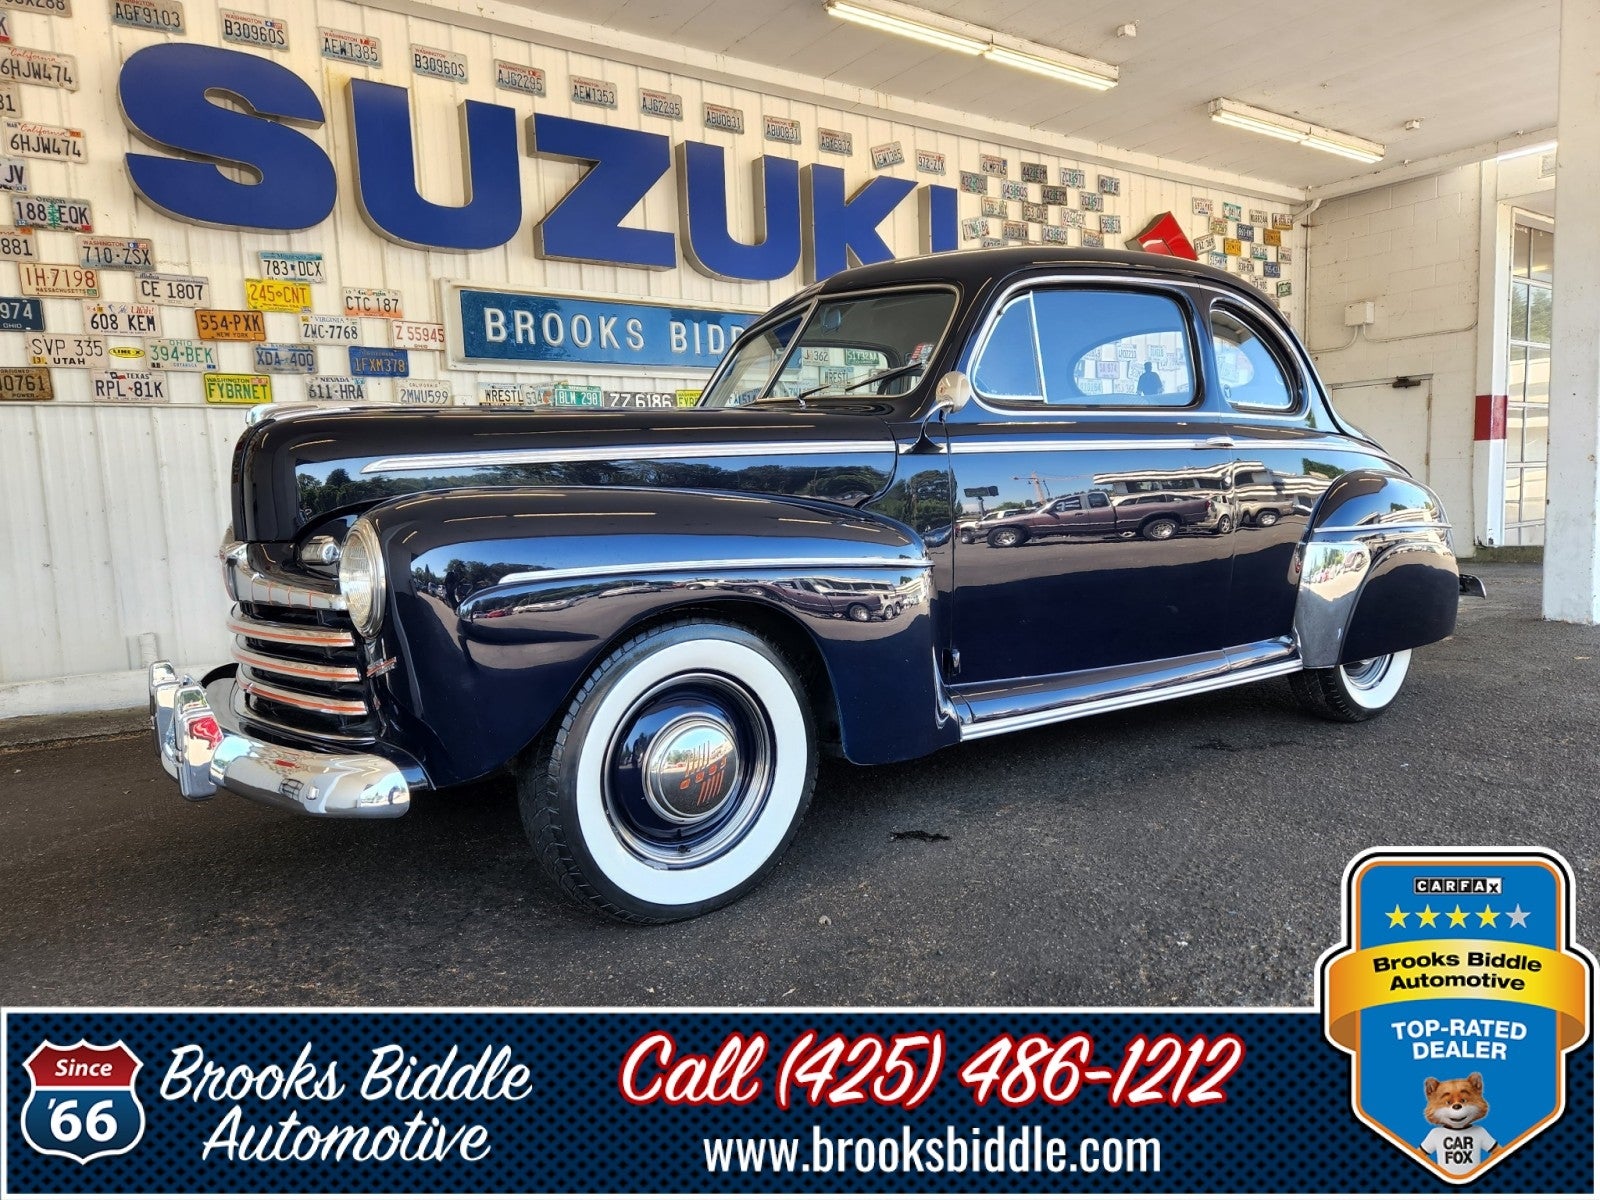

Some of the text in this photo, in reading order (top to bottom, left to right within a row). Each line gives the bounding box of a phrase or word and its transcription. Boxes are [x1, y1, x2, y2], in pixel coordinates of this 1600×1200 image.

[115, 2, 181, 28] AGF9103
[0, 58, 72, 84] 6HJW474
[10, 133, 81, 157] 6HJW474
[118, 42, 959, 284] SUZUKI
[82, 240, 125, 248] WASHINGTON
[263, 259, 323, 277] 783 DCX
[141, 280, 204, 301] CE 1807
[249, 284, 276, 302] 245
[90, 313, 119, 331] 608
[483, 306, 646, 351] BROOKS
[406, 326, 446, 343] 55945
[31, 338, 103, 357] SVP 335
[53, 357, 86, 365] UTAH
[0, 375, 45, 391] 0761
[126, 372, 150, 380] TEXAS
[95, 379, 163, 397] RPL 81K
[208, 382, 268, 399] FYBRNET
